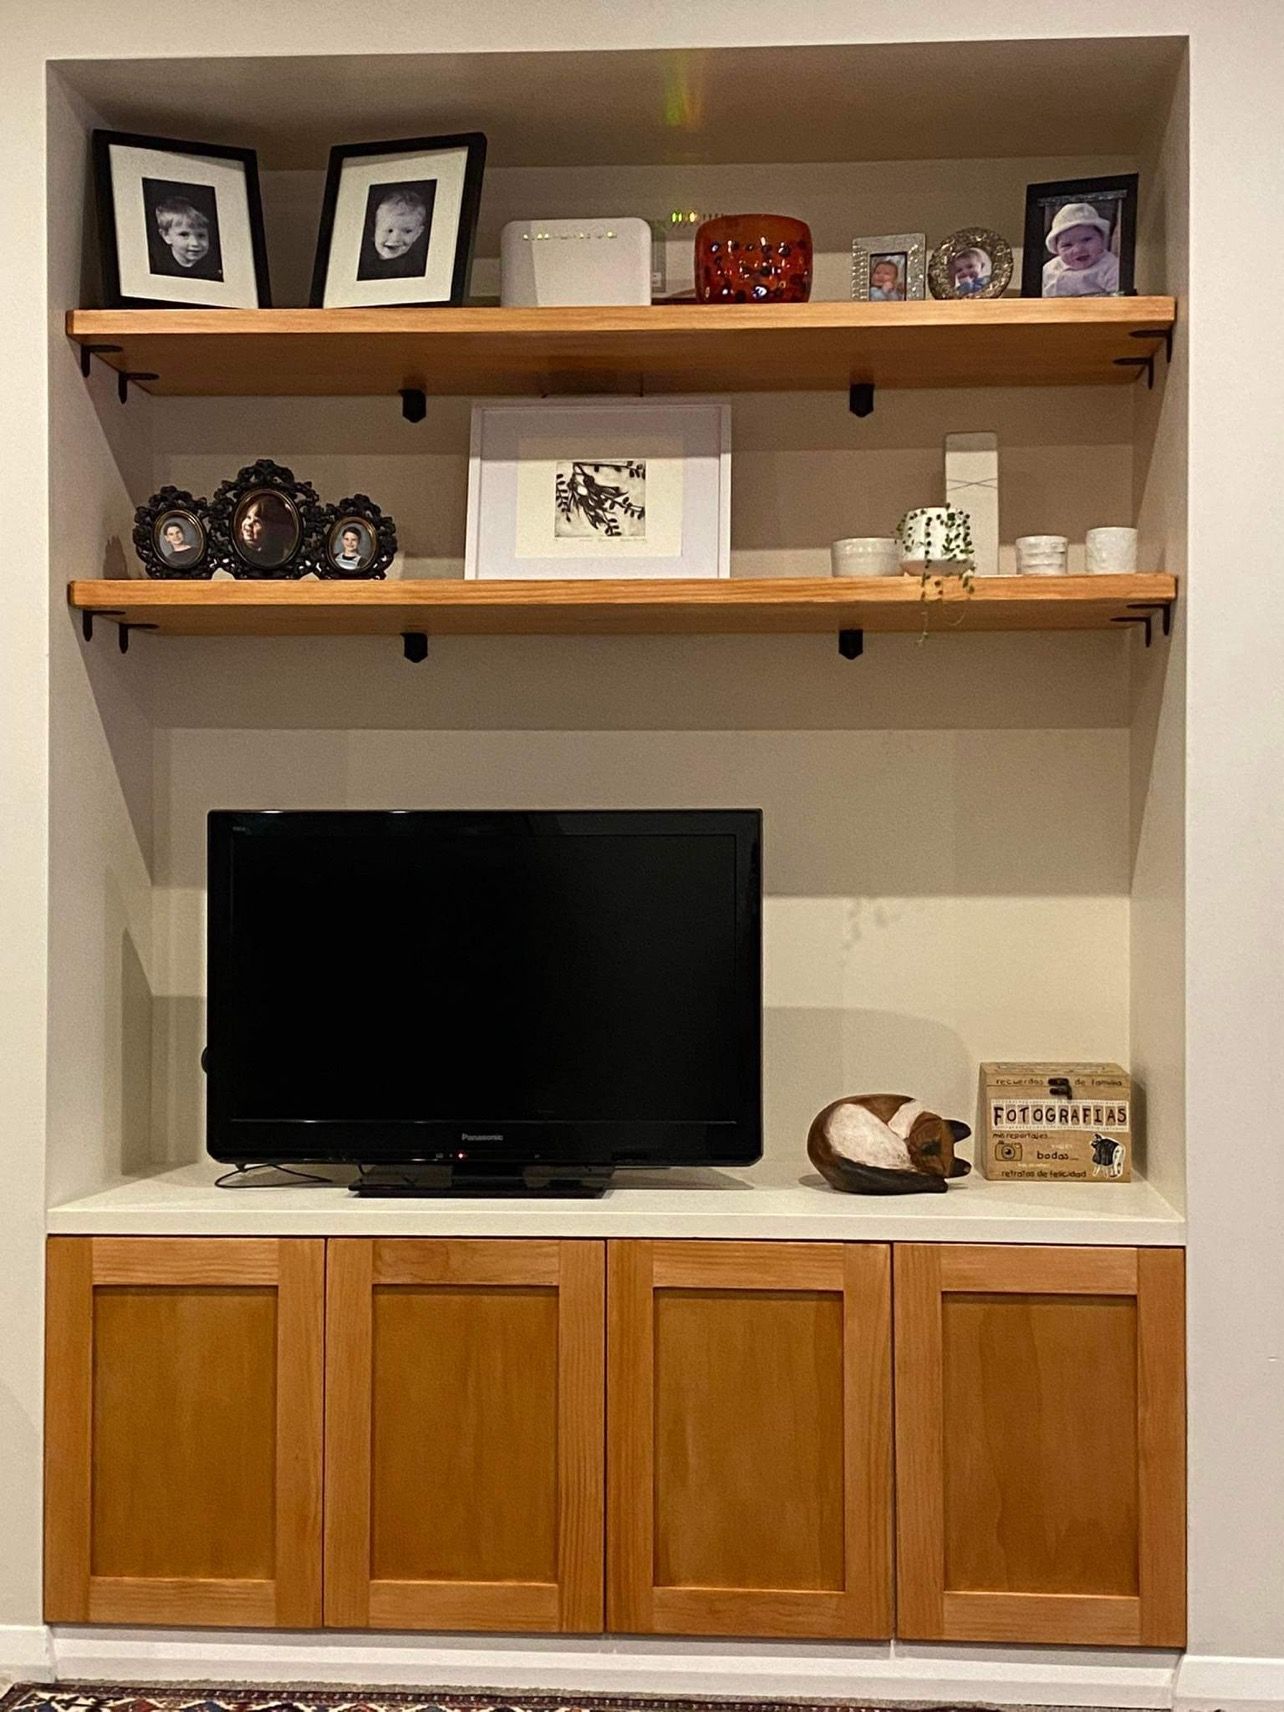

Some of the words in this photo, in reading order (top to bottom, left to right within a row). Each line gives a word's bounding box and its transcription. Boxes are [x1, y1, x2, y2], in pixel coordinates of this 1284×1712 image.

[995, 1077, 1044, 1086] recuerdos
[1074, 1077, 1086, 1086] de
[993, 1106, 1127, 1126] FOTOGRAFIAS
[461, 1132, 504, 1141] Panasonic
[1001, 1169, 1035, 1178] retratos
[1036, 1169, 1049, 1178] de
